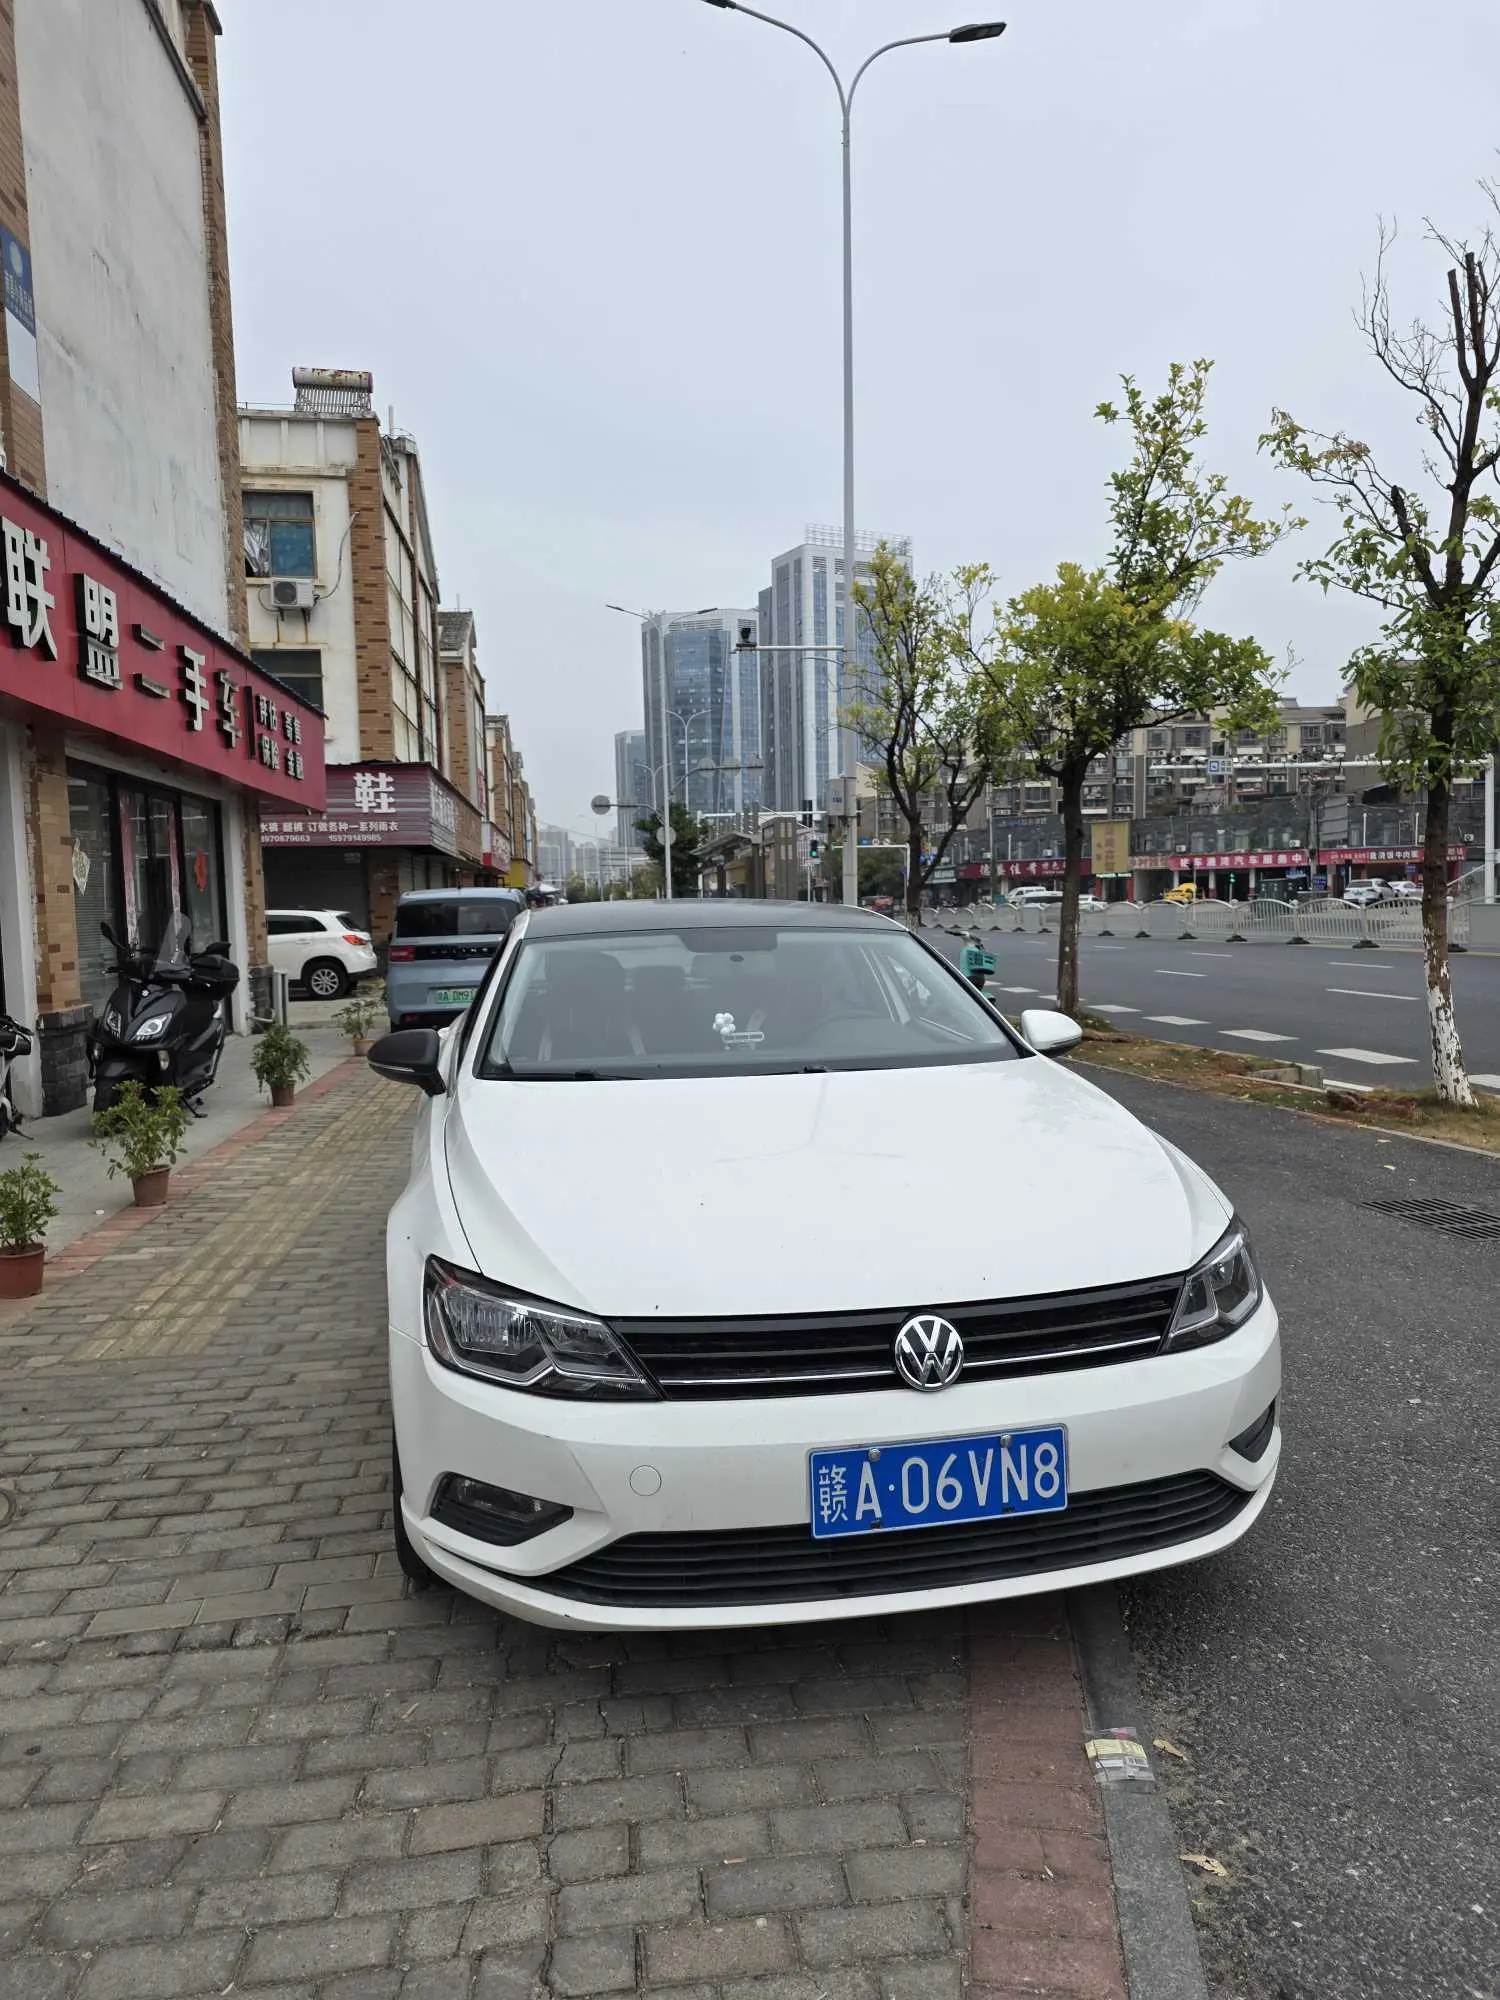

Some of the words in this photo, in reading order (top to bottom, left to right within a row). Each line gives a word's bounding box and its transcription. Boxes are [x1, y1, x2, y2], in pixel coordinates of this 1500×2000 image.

[0, 515, 243, 749] 联盟二手车
[353, 772, 397, 814] 鞋
[818, 1441, 1060, 1525] 赣A·06VN8
